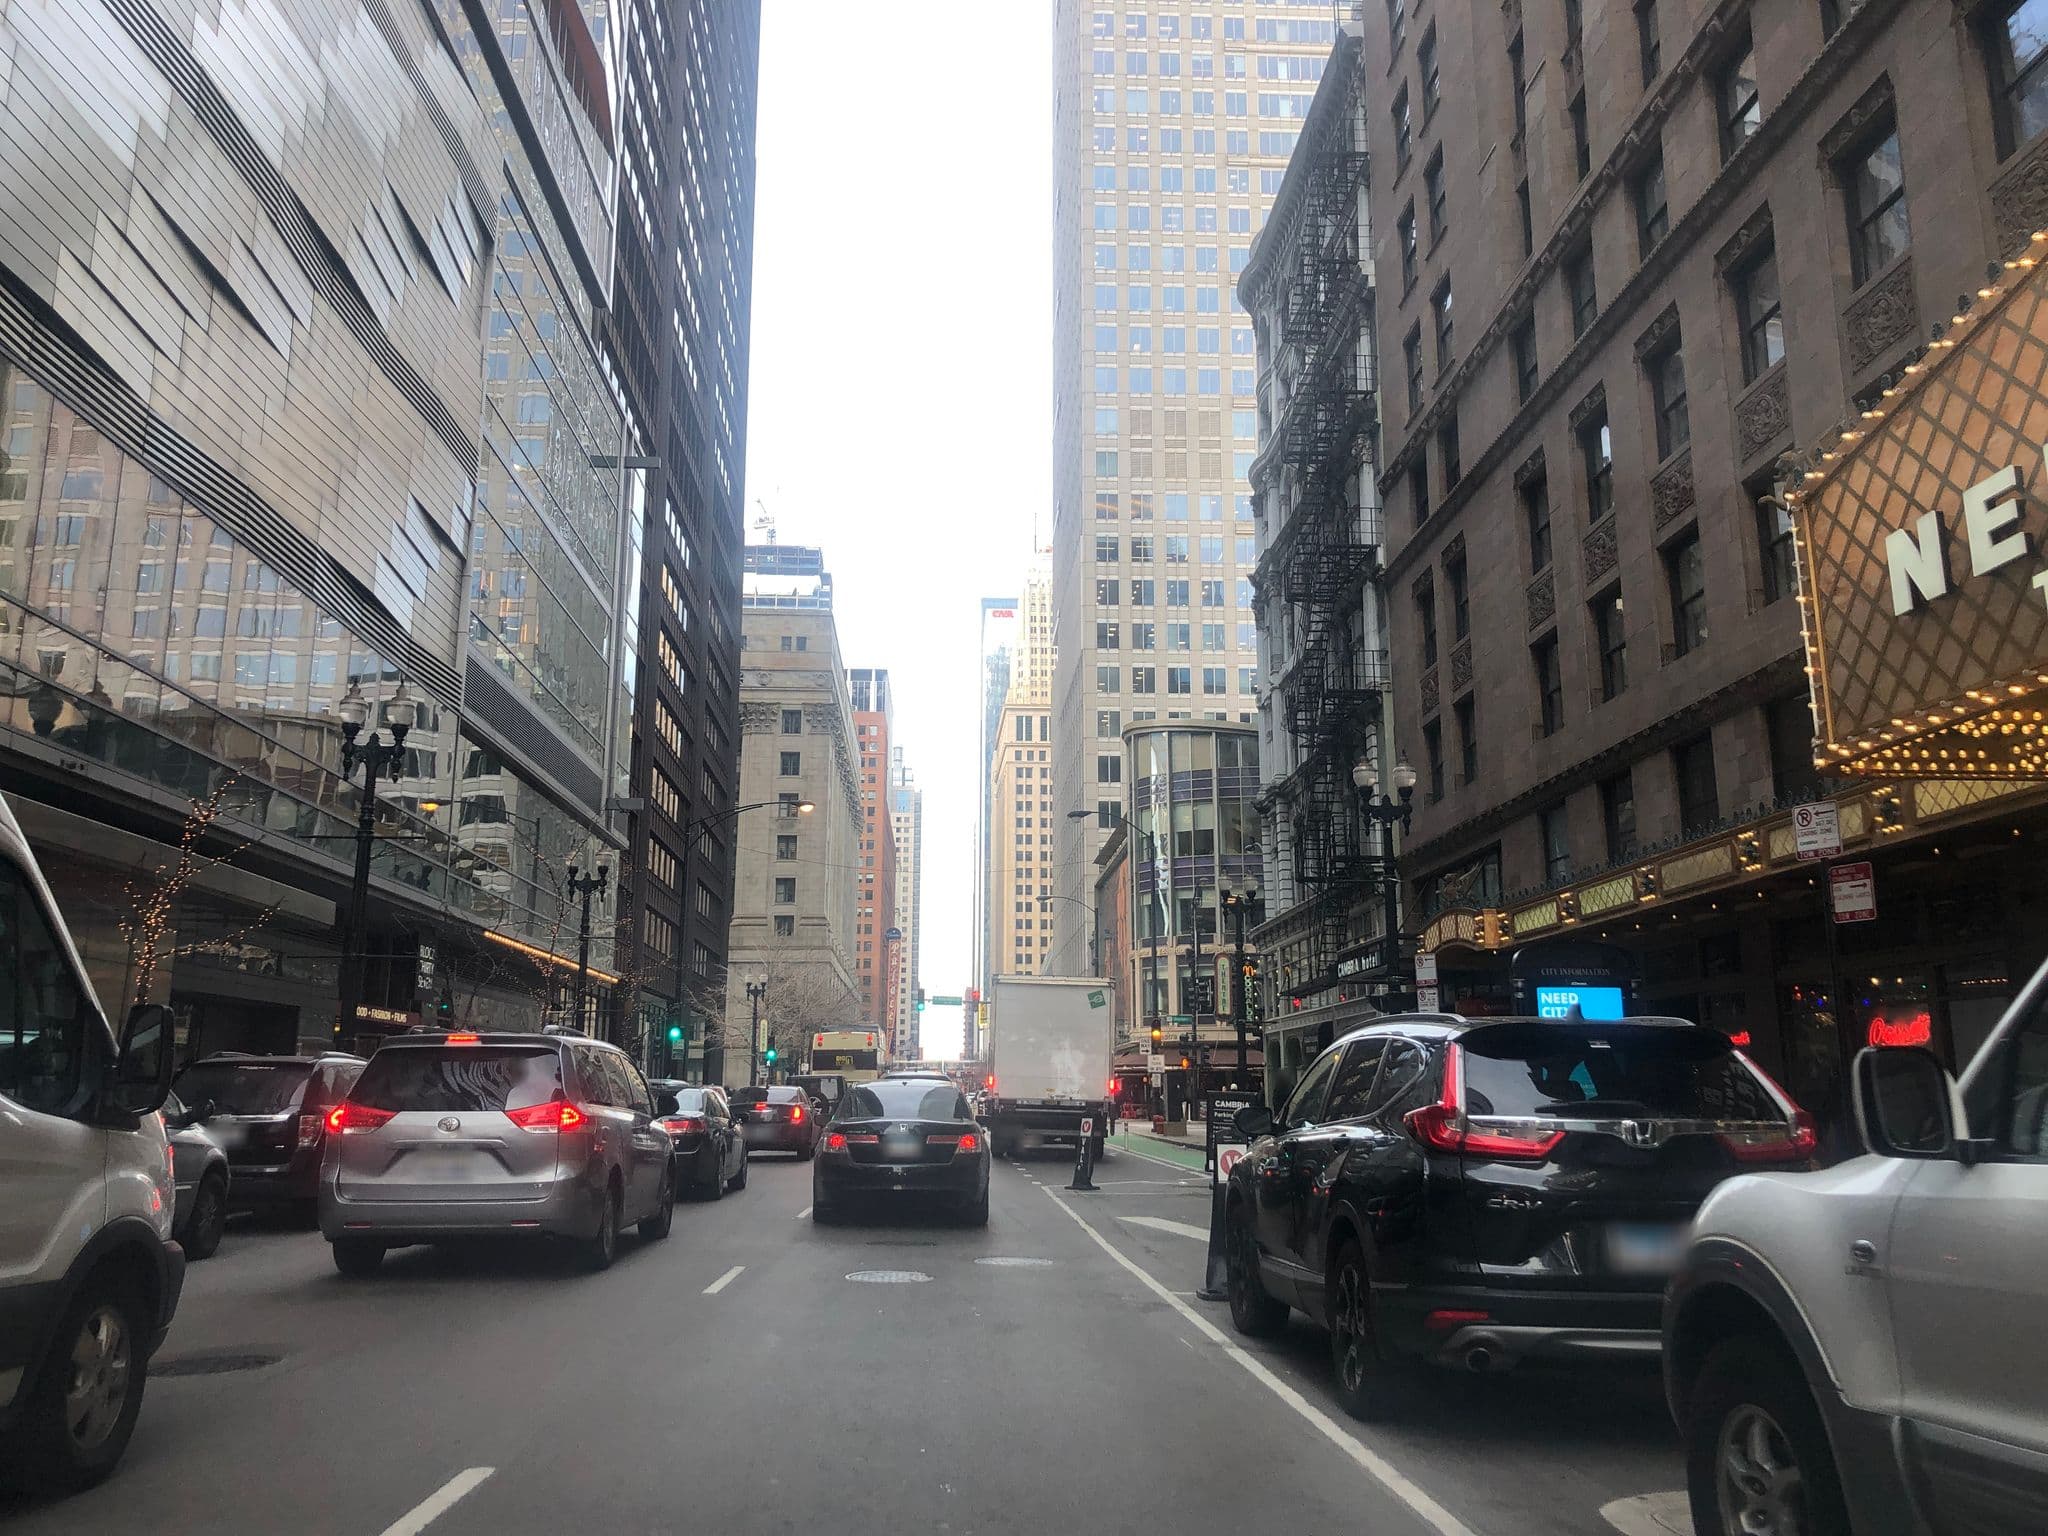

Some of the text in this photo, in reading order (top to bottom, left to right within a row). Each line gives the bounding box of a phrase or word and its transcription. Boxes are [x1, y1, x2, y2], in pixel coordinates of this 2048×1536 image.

[1885, 443, 2048, 616] NE
[1818, 847, 1838, 856] ZONE
[1338, 951, 1378, 978] CAMBRIA hotel
[1540, 967, 1611, 976] CITY INFORMATION
[1541, 992, 1579, 1004] NEED
[356, 1006, 407, 1023] OOD FASHION FILMS
[1215, 1100, 1250, 1108] CAMBRIA
